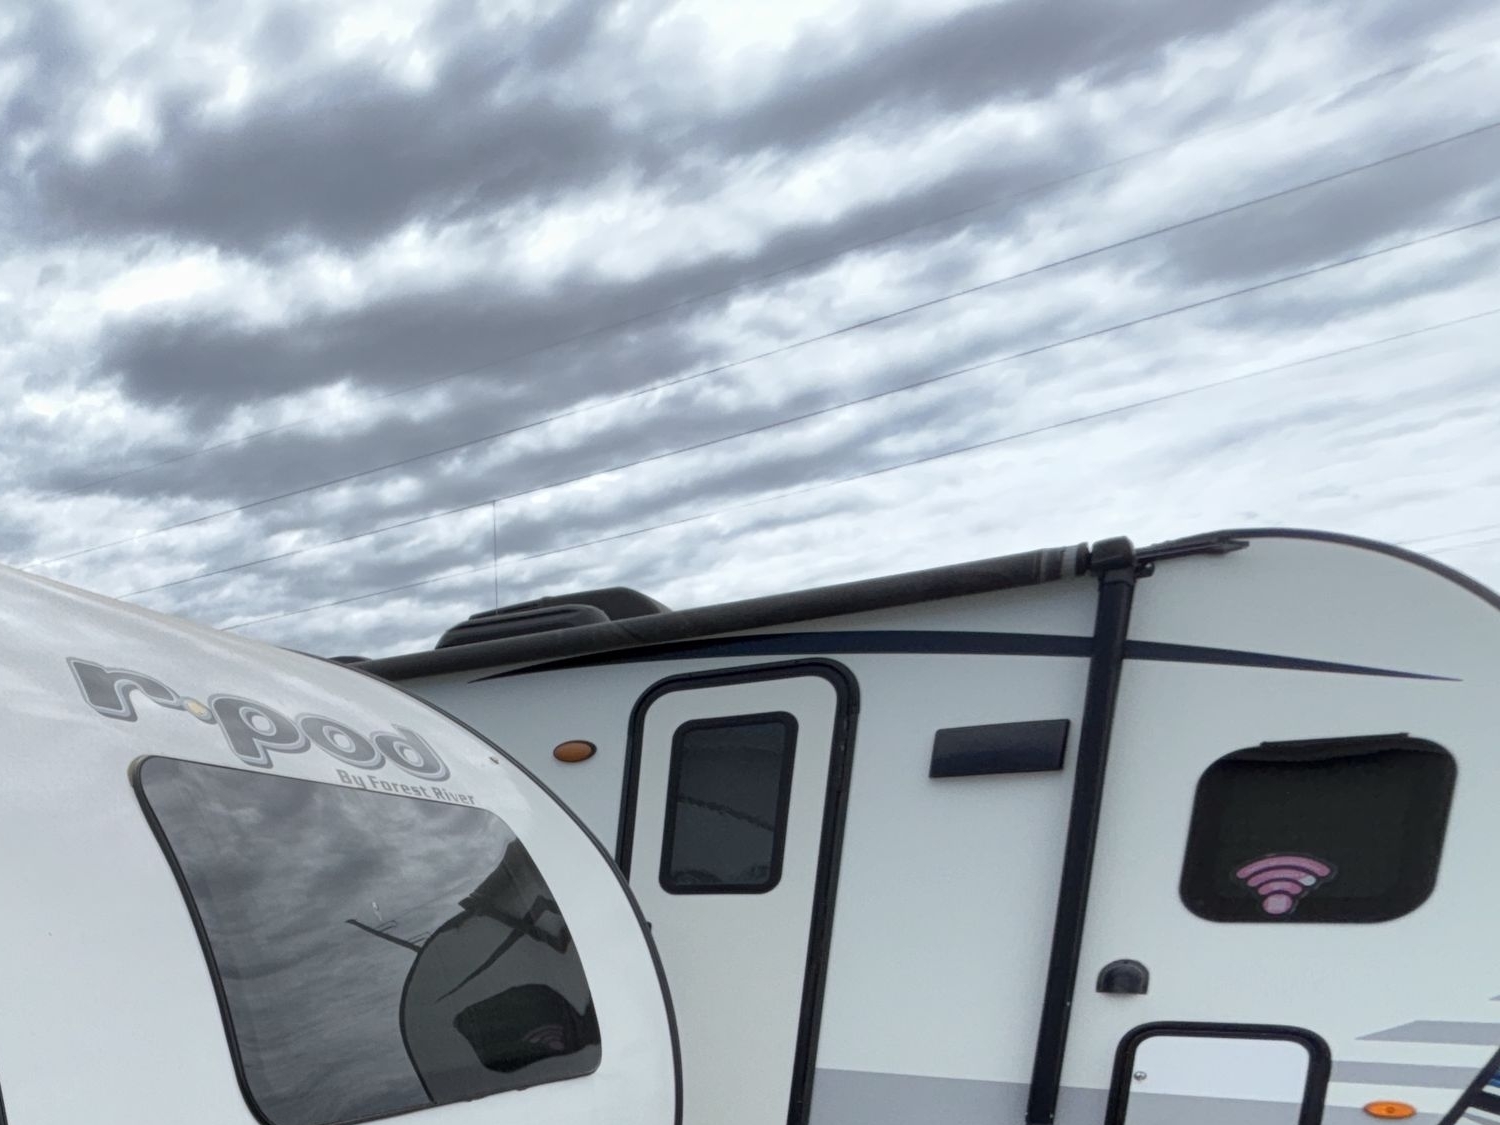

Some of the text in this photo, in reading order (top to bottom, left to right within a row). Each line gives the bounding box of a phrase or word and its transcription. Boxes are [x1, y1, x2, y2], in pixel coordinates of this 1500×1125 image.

[336, 768, 476, 806] By Forest River
